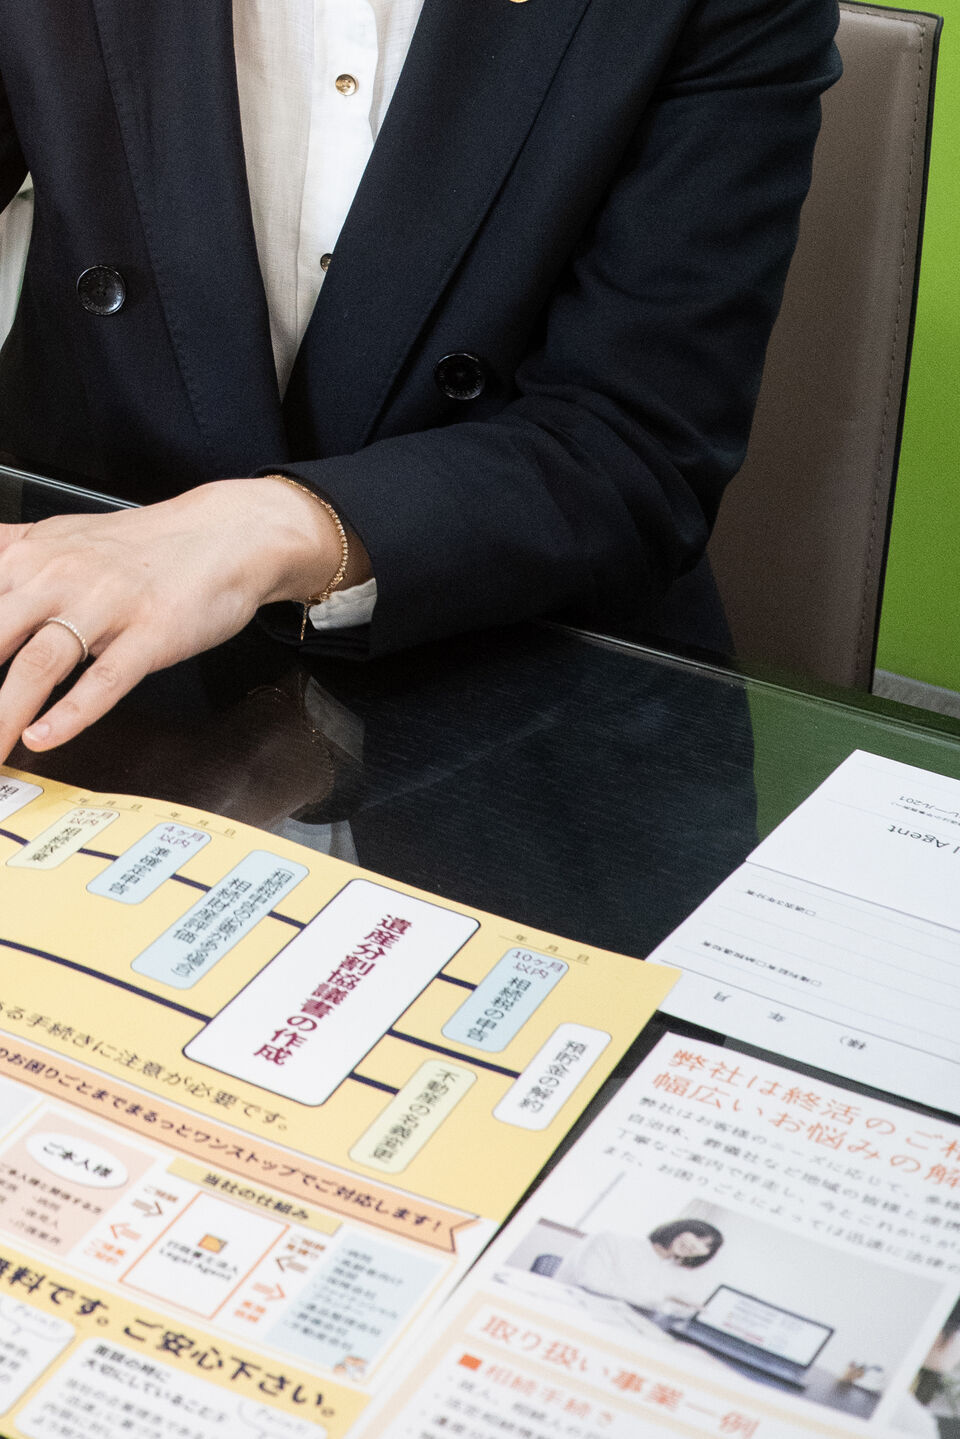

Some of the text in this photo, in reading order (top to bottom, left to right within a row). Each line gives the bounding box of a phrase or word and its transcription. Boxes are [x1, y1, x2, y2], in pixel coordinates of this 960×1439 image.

[887, 824, 951, 849] Agent
[108, 845, 172, 896] 準確定申告
[172, 877, 253, 945] 相続財産評価
[253, 914, 413, 1066] 遺産分割協議書の作成
[467, 976, 533, 1043] 相続税の申告
[519, 1039, 589, 1113] 預貯金の解約
[370, 1067, 461, 1164] 不動産の名義変更
[42, 1141, 114, 1178] ご本人様
[203, 1172, 310, 1221] 当社の仕組み
